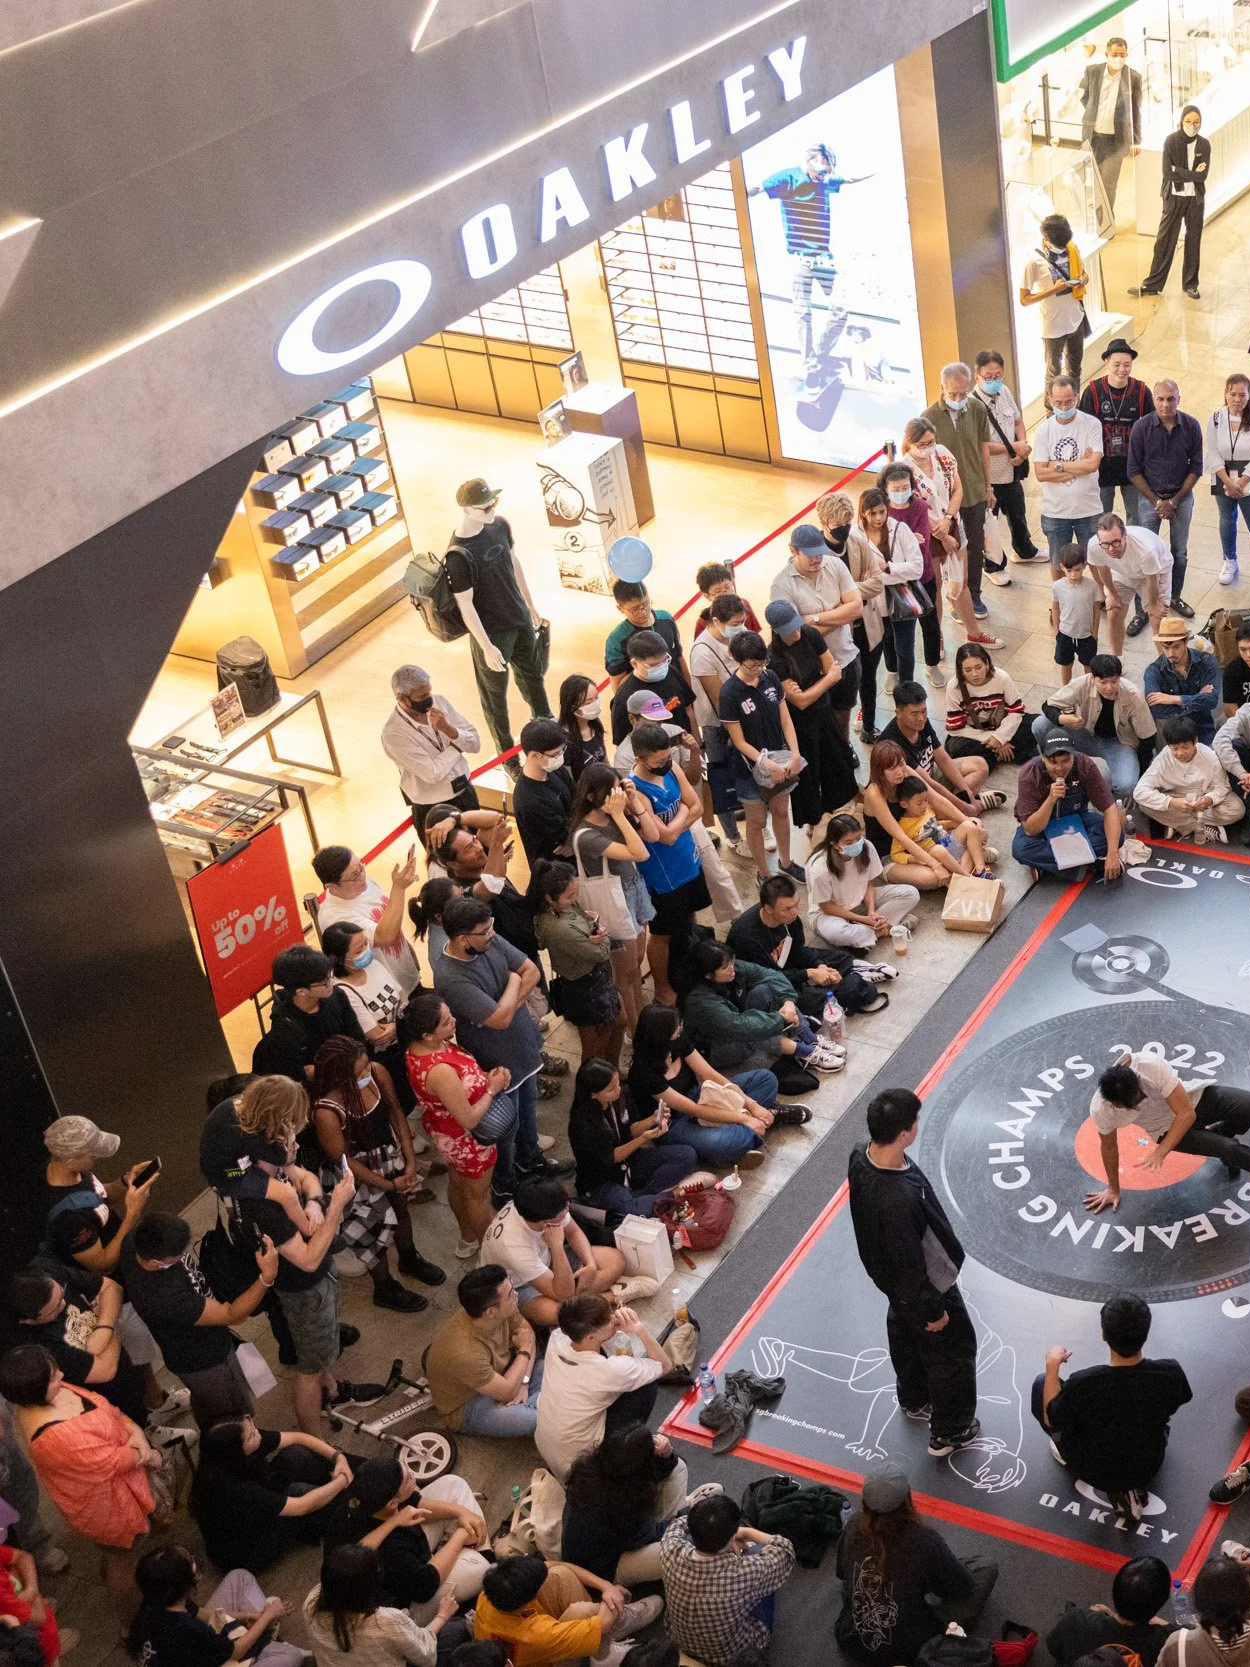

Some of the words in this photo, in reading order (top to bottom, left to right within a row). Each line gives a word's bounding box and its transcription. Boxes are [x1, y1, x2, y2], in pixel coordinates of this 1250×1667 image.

[460, 36, 806, 280] OAKLEY
[569, 535, 580, 548] 2
[741, 698, 757, 715] 05
[214, 895, 287, 959] 50%
[227, 908, 240, 921] to
[274, 917, 288, 936] off
[988, 1054, 1095, 1190] CHAMPS
[380, 1398, 427, 1425] STRIDER
[1038, 1493, 1179, 1544] OAKLEY
